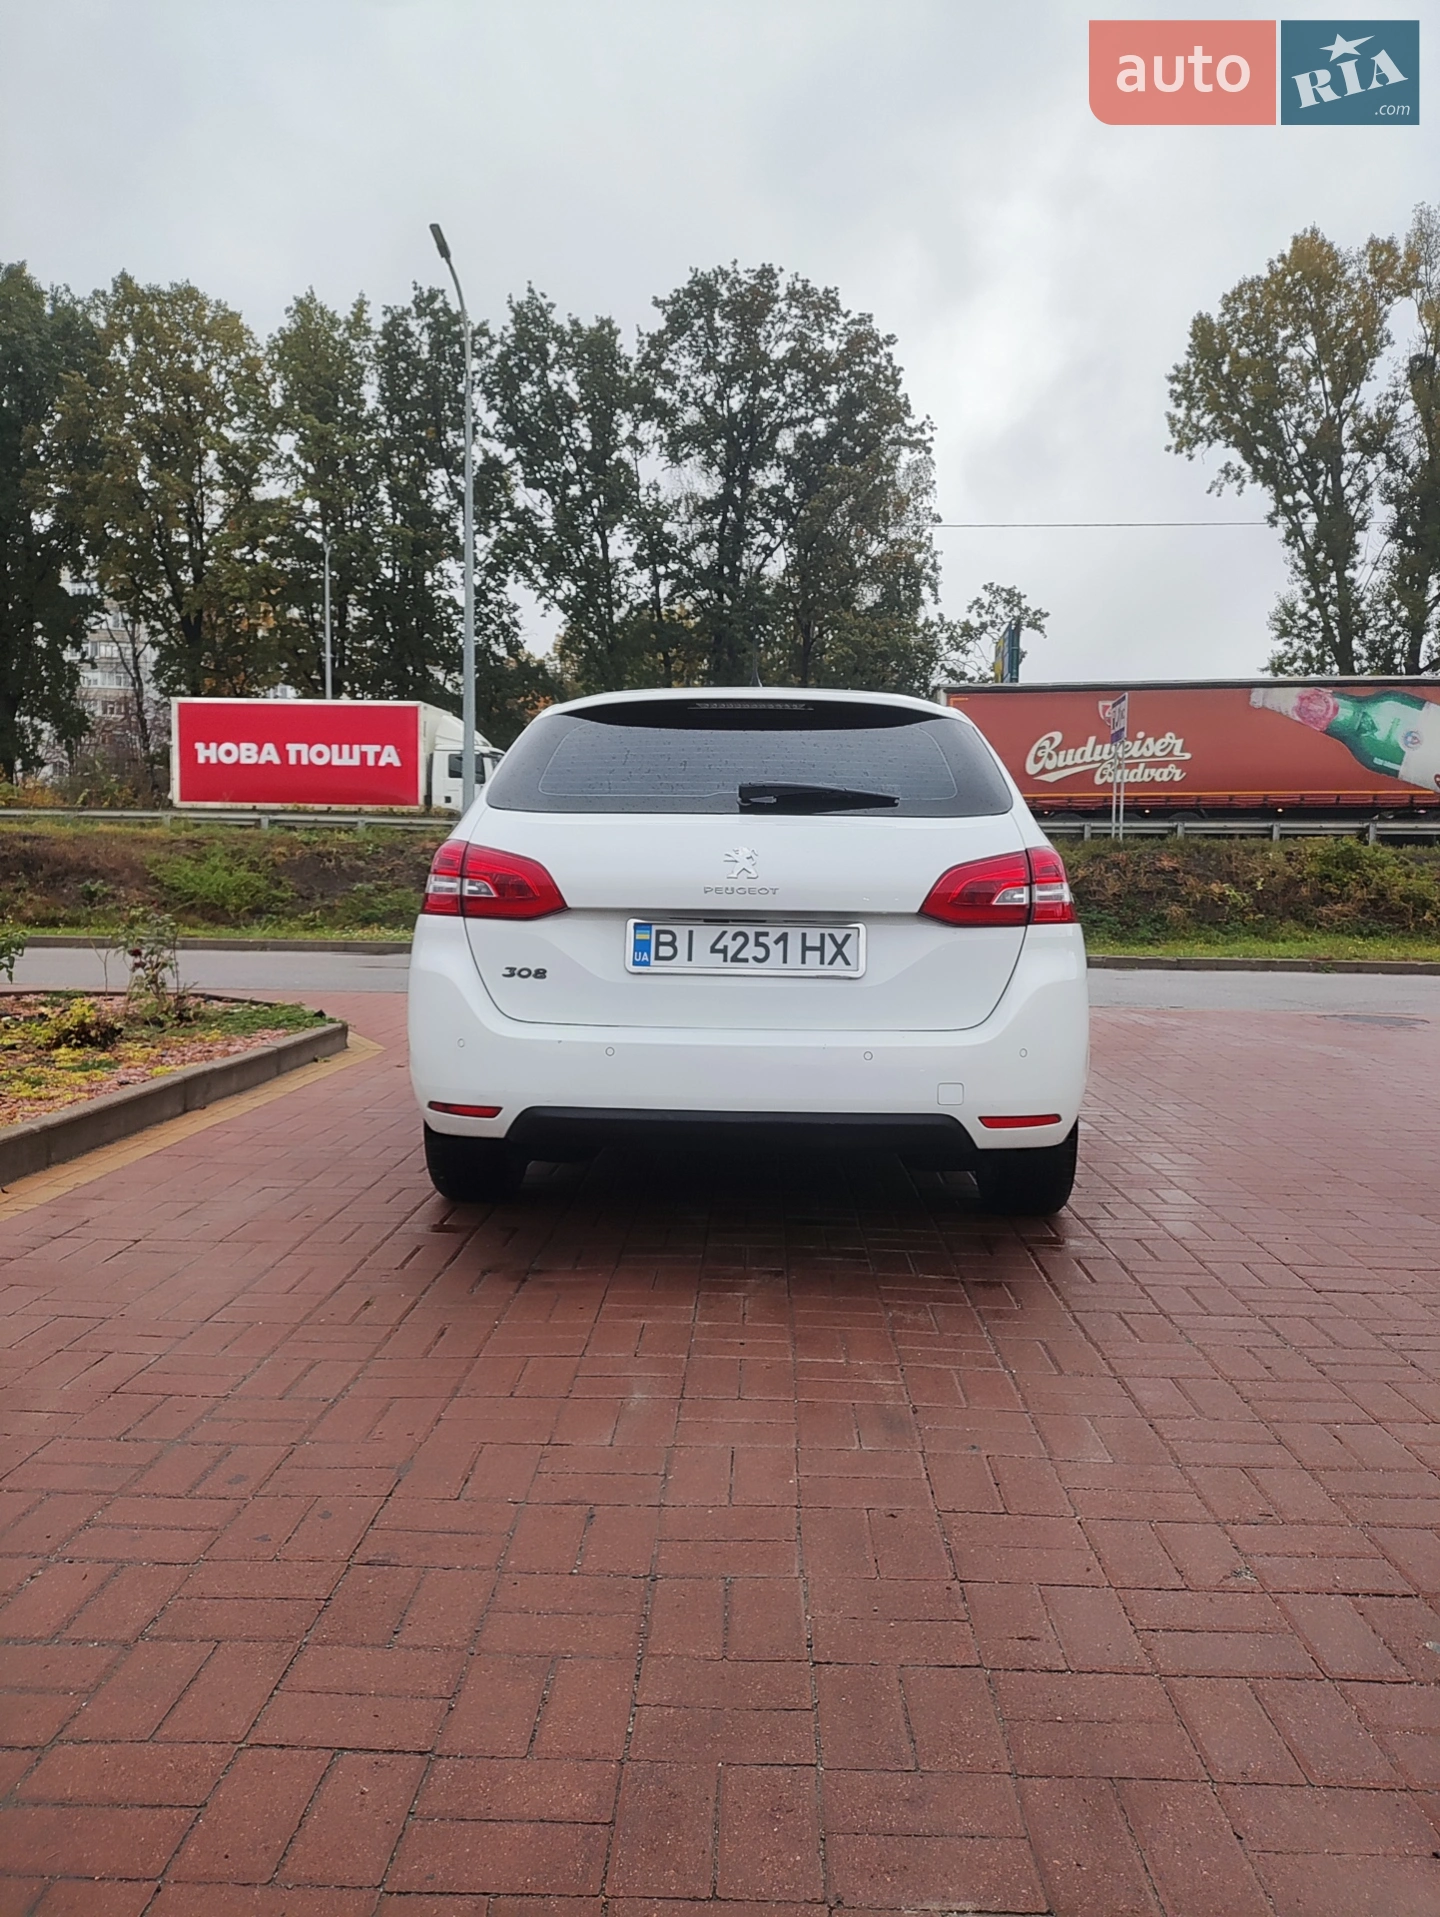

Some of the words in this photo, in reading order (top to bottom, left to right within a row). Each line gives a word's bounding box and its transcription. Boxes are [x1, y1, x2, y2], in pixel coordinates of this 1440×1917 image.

[194, 742, 281, 765] НОВА
[286, 743, 402, 767] ПОШТА
[1025, 731, 1192, 782] Budweiser
[703, 886, 780, 896] PEUGEOT
[634, 951, 650, 962] UA
[709, 930, 789, 965] 4251
[800, 932, 852, 967] HX
[501, 966, 548, 980] 308
